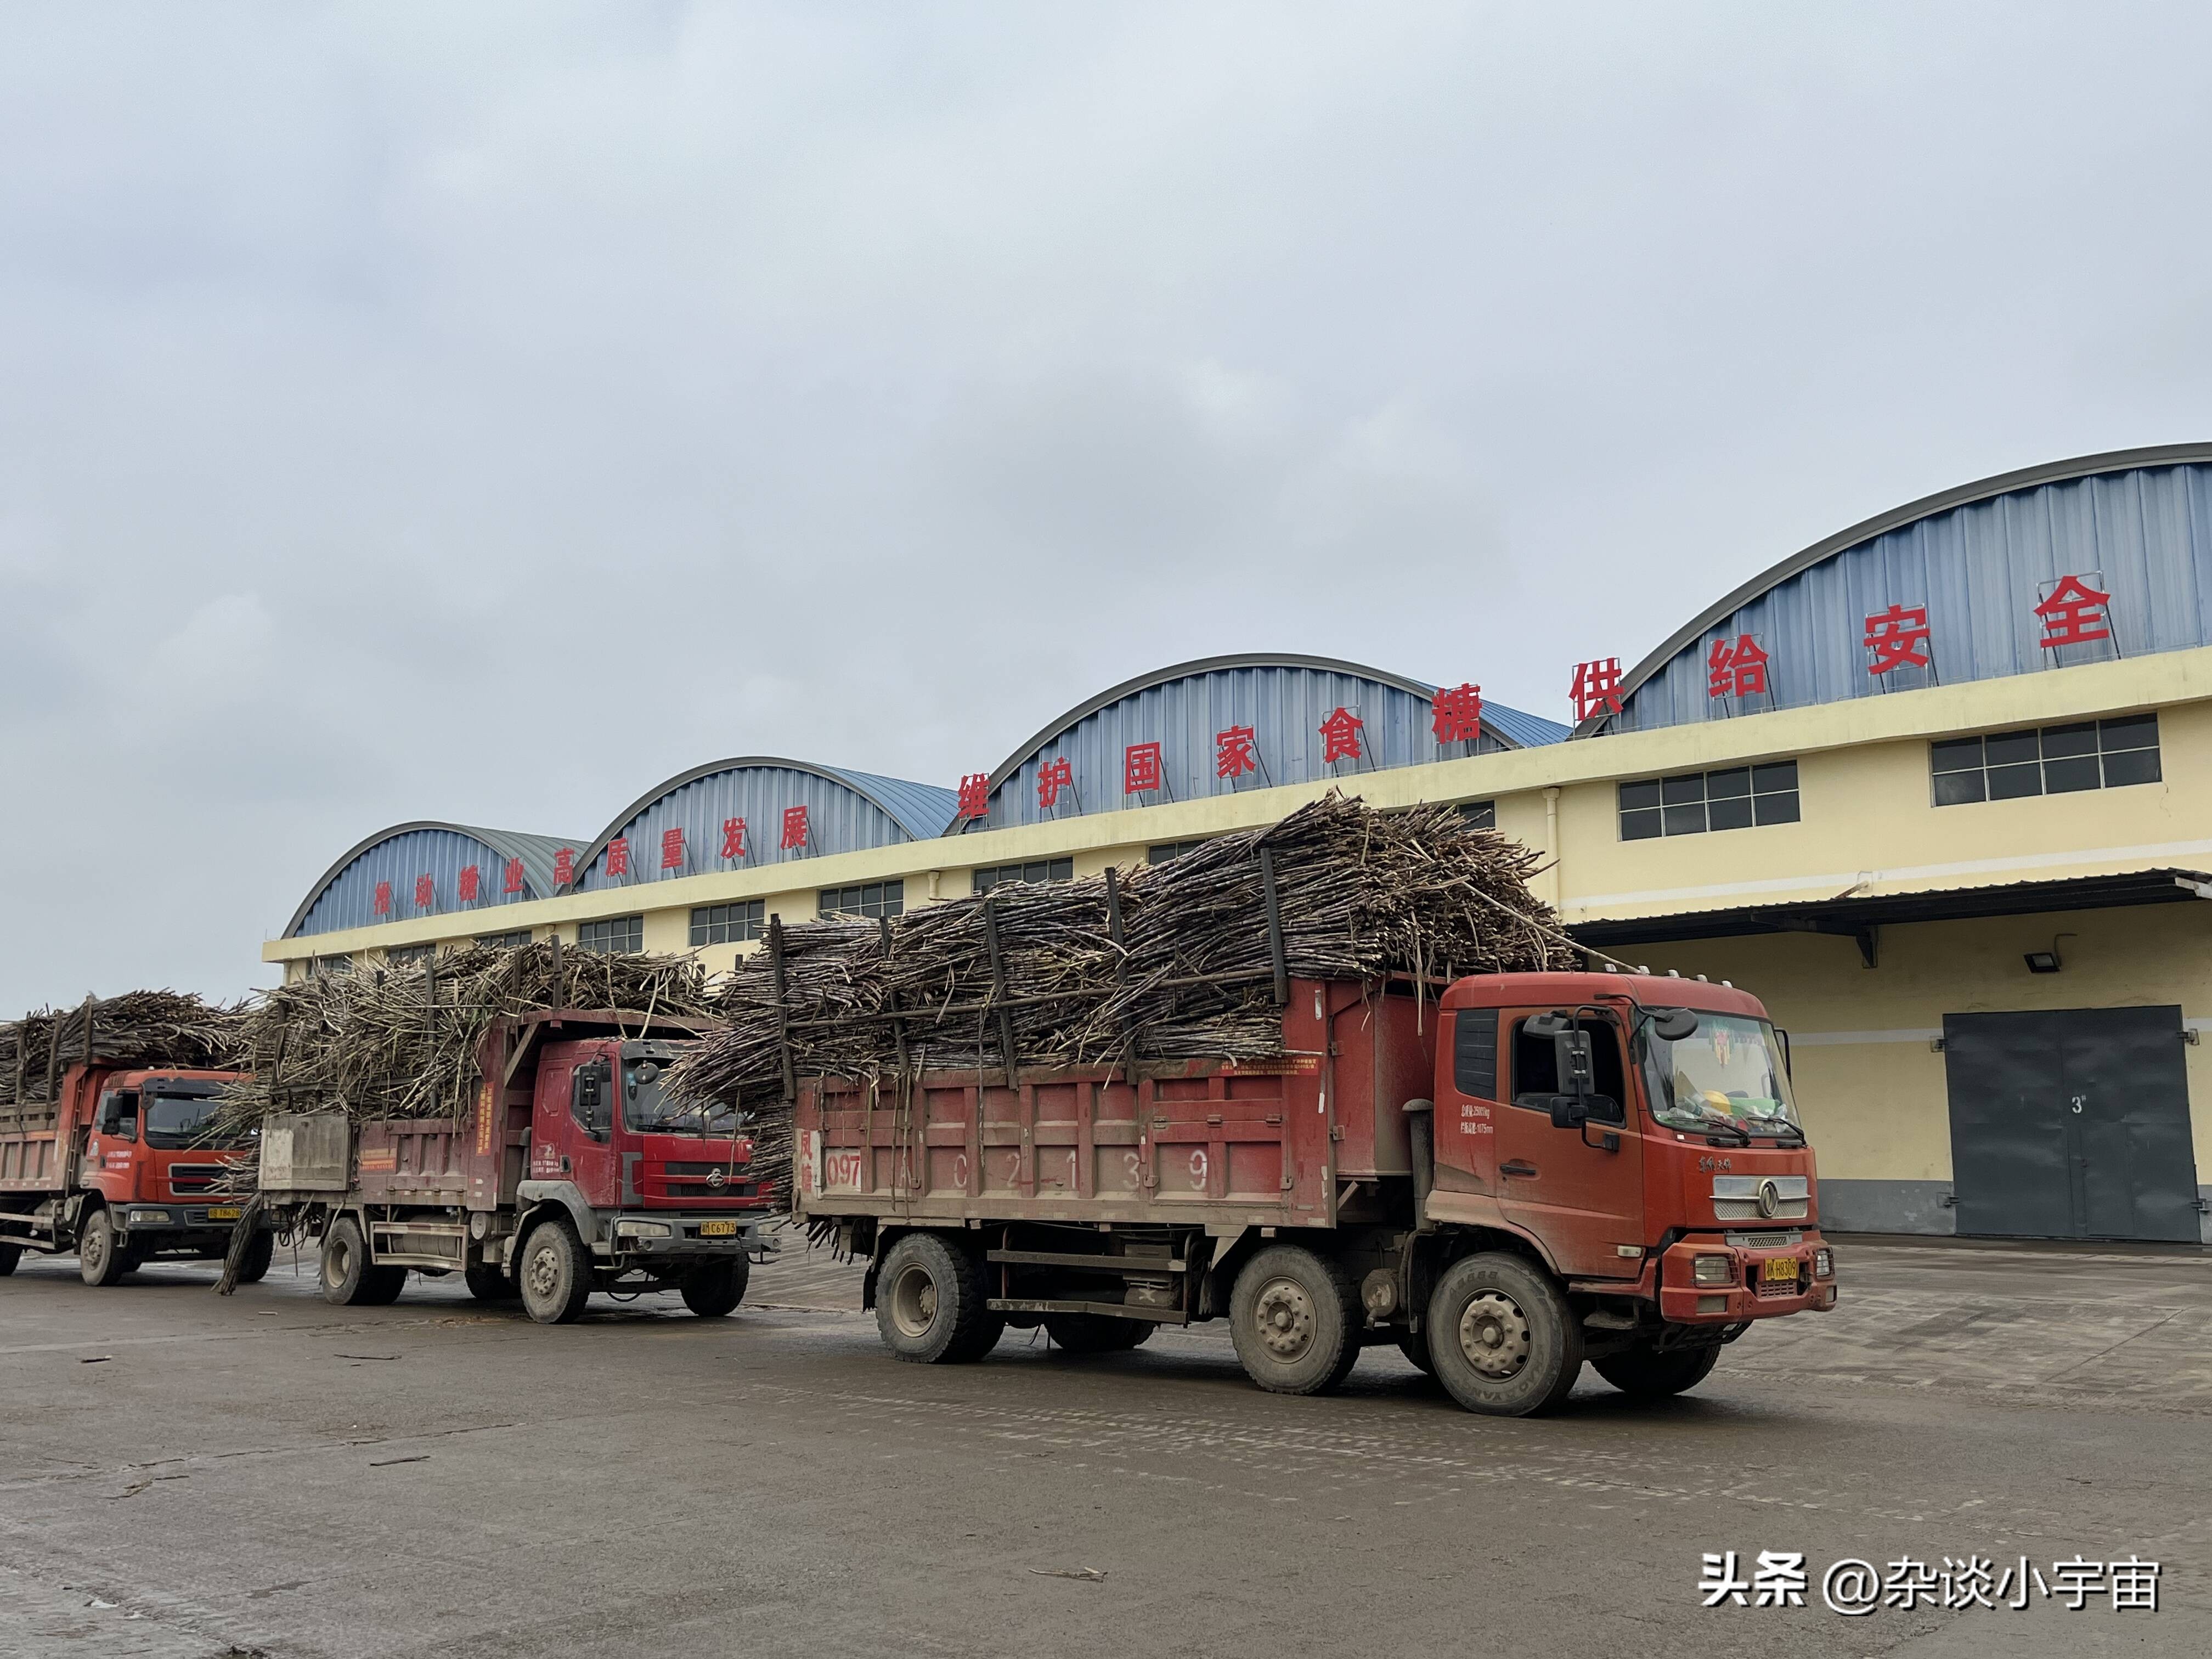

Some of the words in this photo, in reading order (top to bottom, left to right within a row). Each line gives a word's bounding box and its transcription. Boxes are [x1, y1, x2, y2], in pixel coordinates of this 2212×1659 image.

[374, 805, 808, 915] 推动糖业高质量发展
[958, 575, 2111, 819] 维护国家食糖供给安全
[827, 1154, 861, 1186] 097
